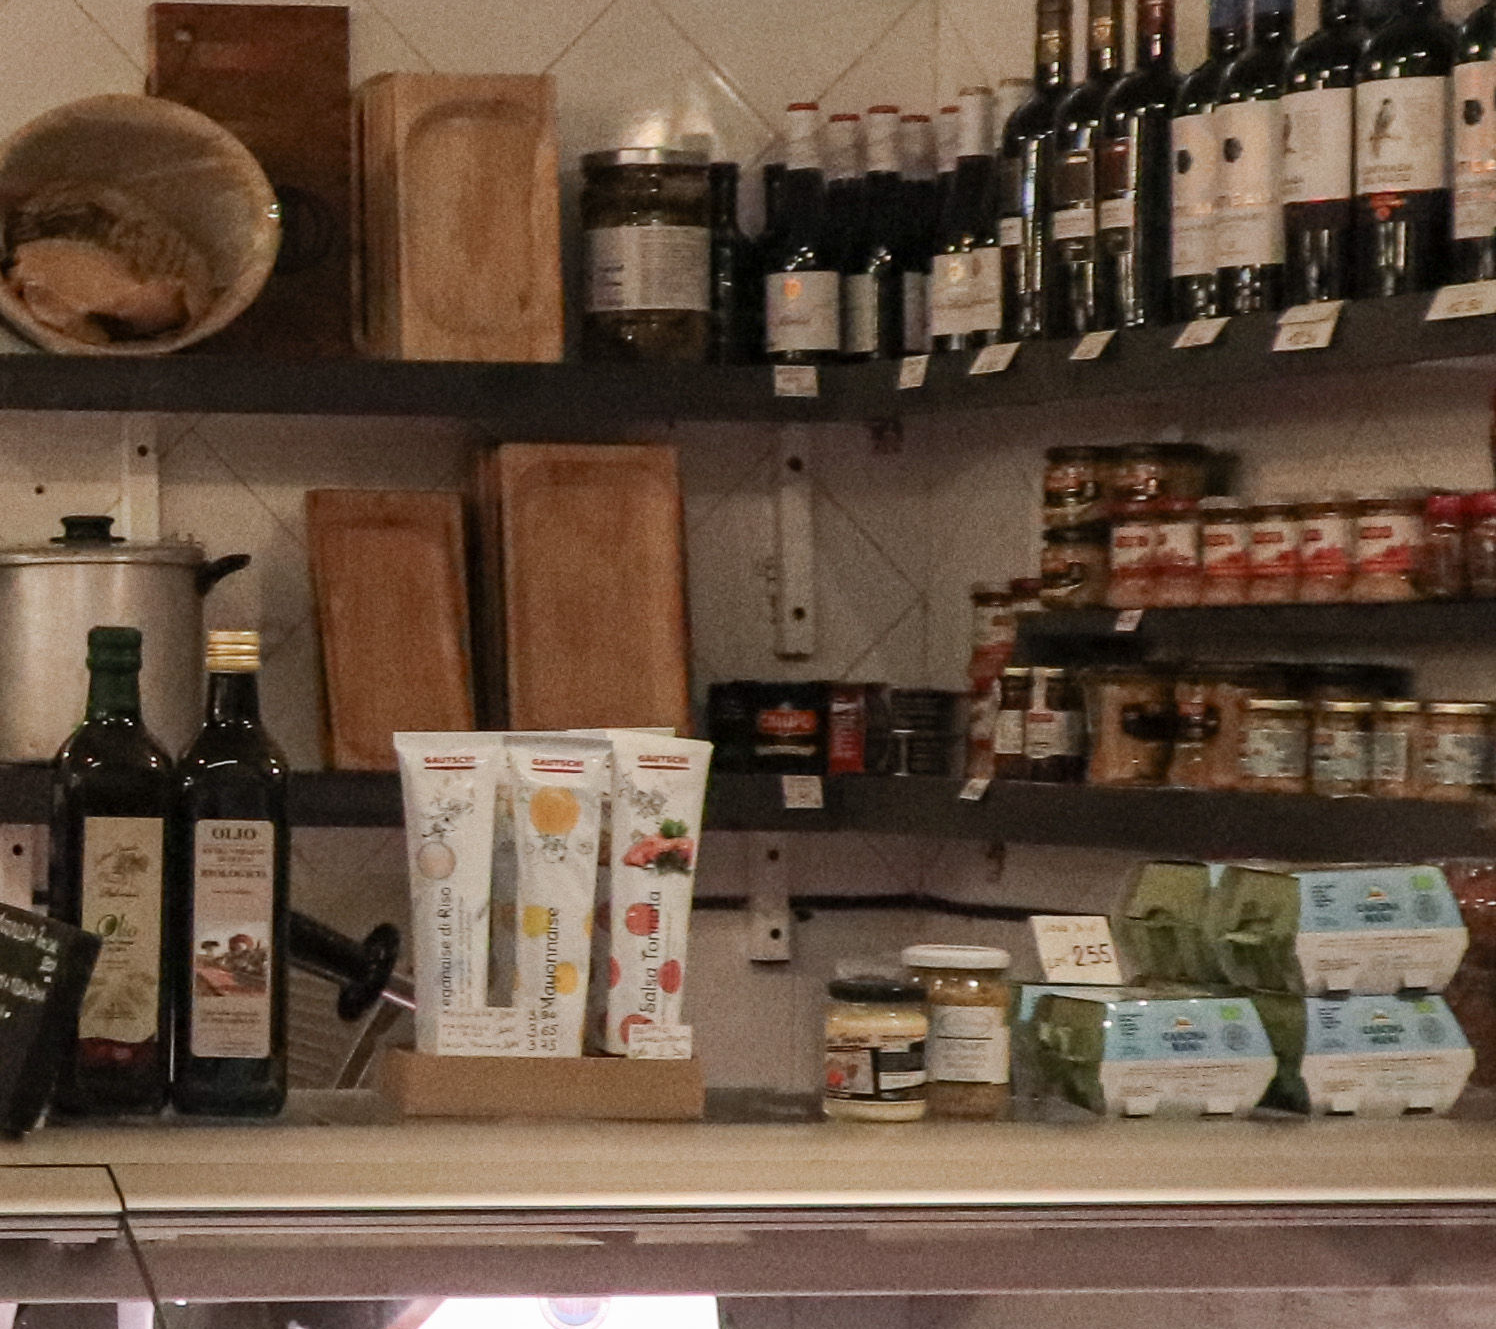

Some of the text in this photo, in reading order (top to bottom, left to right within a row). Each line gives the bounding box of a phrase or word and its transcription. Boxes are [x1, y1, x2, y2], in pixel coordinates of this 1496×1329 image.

[637, 754, 690, 766] GAUTSCHI
[211, 827, 258, 842] OLIO
[438, 886, 452, 920] Riso
[539, 906, 561, 1008] Mayonnaise
